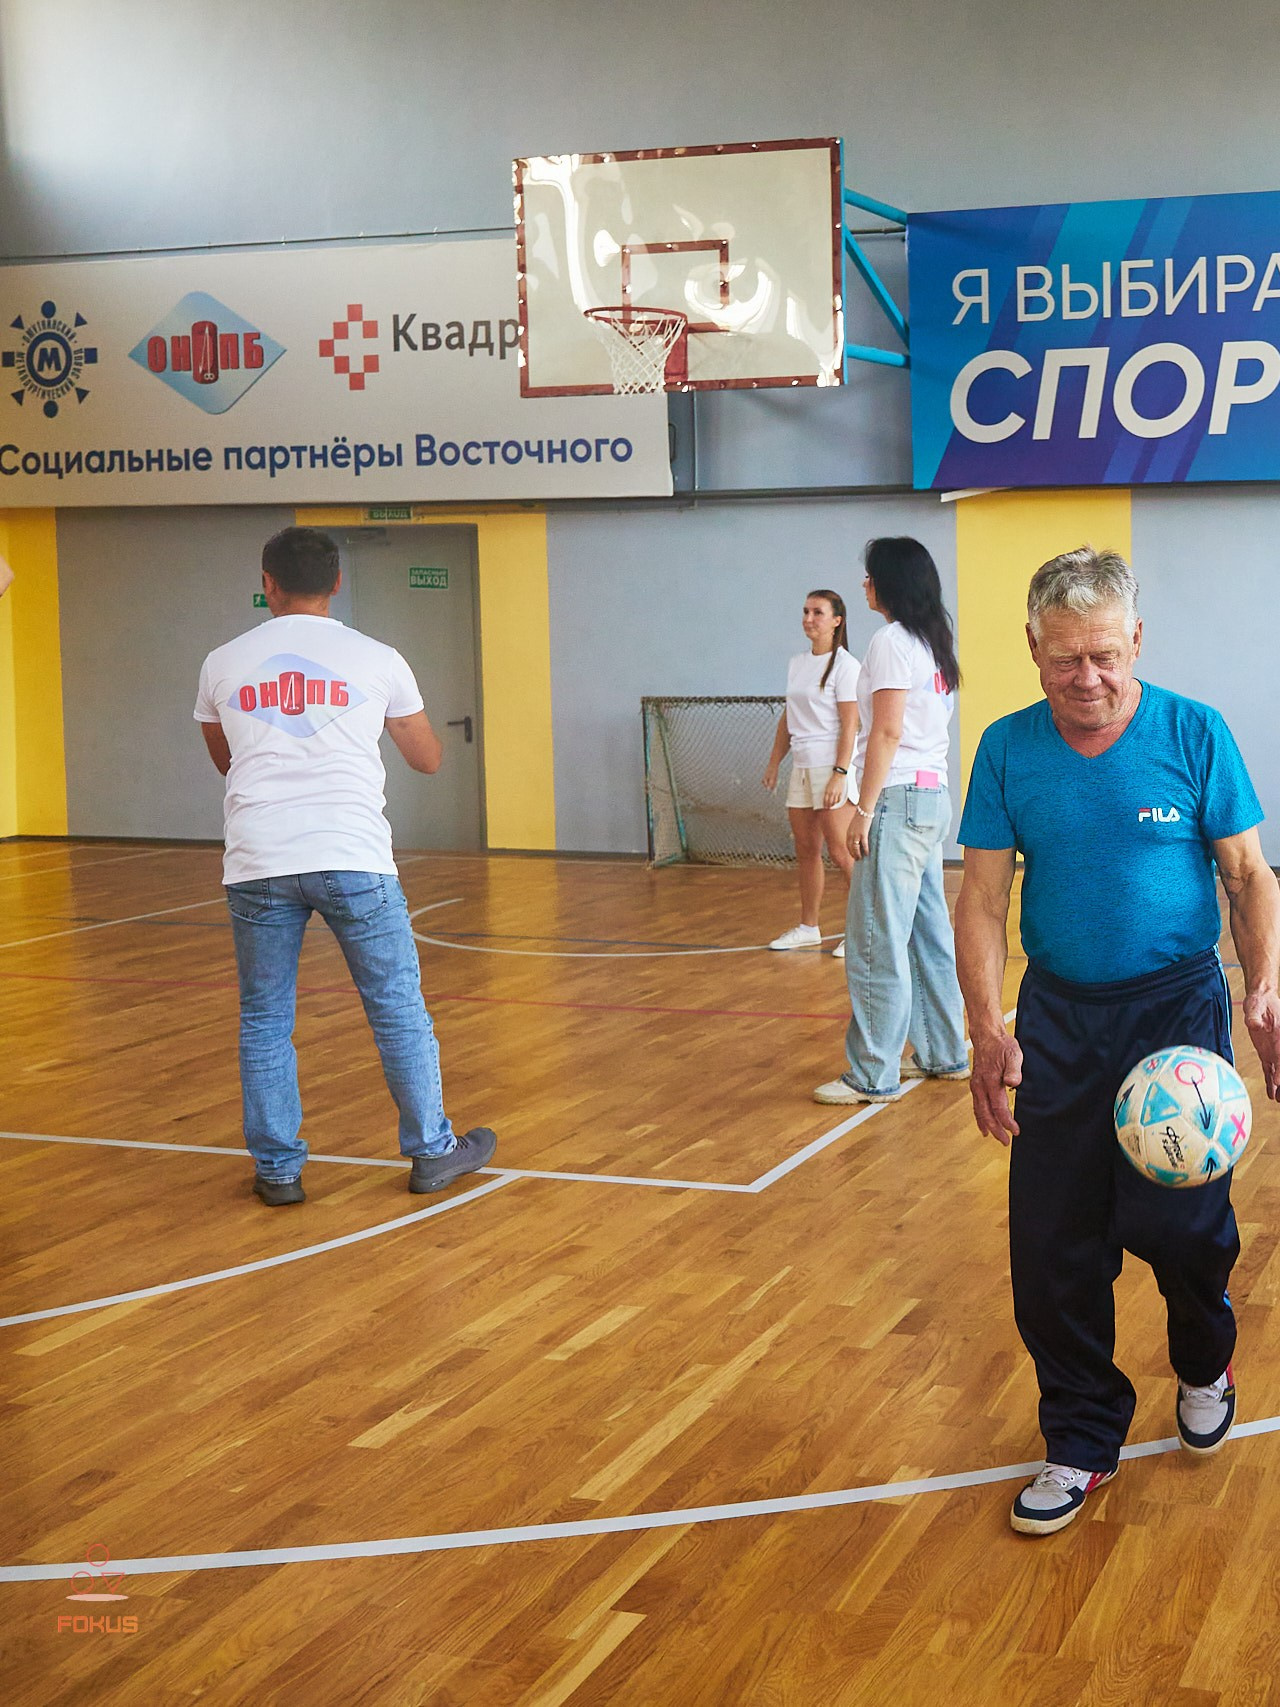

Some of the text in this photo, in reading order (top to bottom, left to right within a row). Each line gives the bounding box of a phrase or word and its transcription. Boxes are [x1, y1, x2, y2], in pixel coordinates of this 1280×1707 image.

[951, 268, 990, 325] Я
[0, 434, 633, 480] Социальные партнёры Восточного
[411, 575, 447, 587] ВЫХОД
[1138, 807, 1180, 822] FILA
